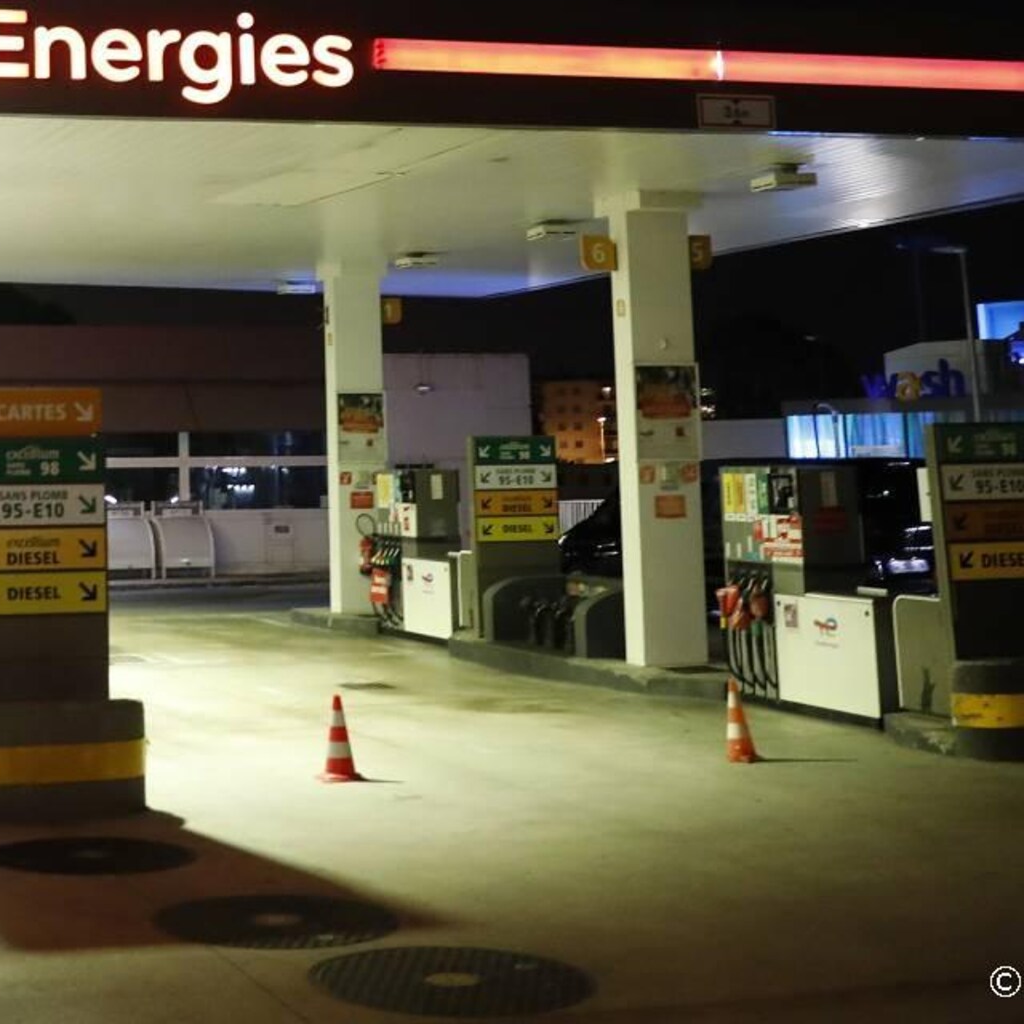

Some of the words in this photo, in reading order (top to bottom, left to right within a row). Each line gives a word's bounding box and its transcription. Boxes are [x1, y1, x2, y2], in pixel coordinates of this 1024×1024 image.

[591, 242, 606, 263] 6
[860, 358, 966, 403] wash
[40, 461, 60, 476] 98
[1, 502, 64, 519] 95-E10
[7, 551, 61, 566] DIESEL
[7, 587, 61, 602] DIESEL
